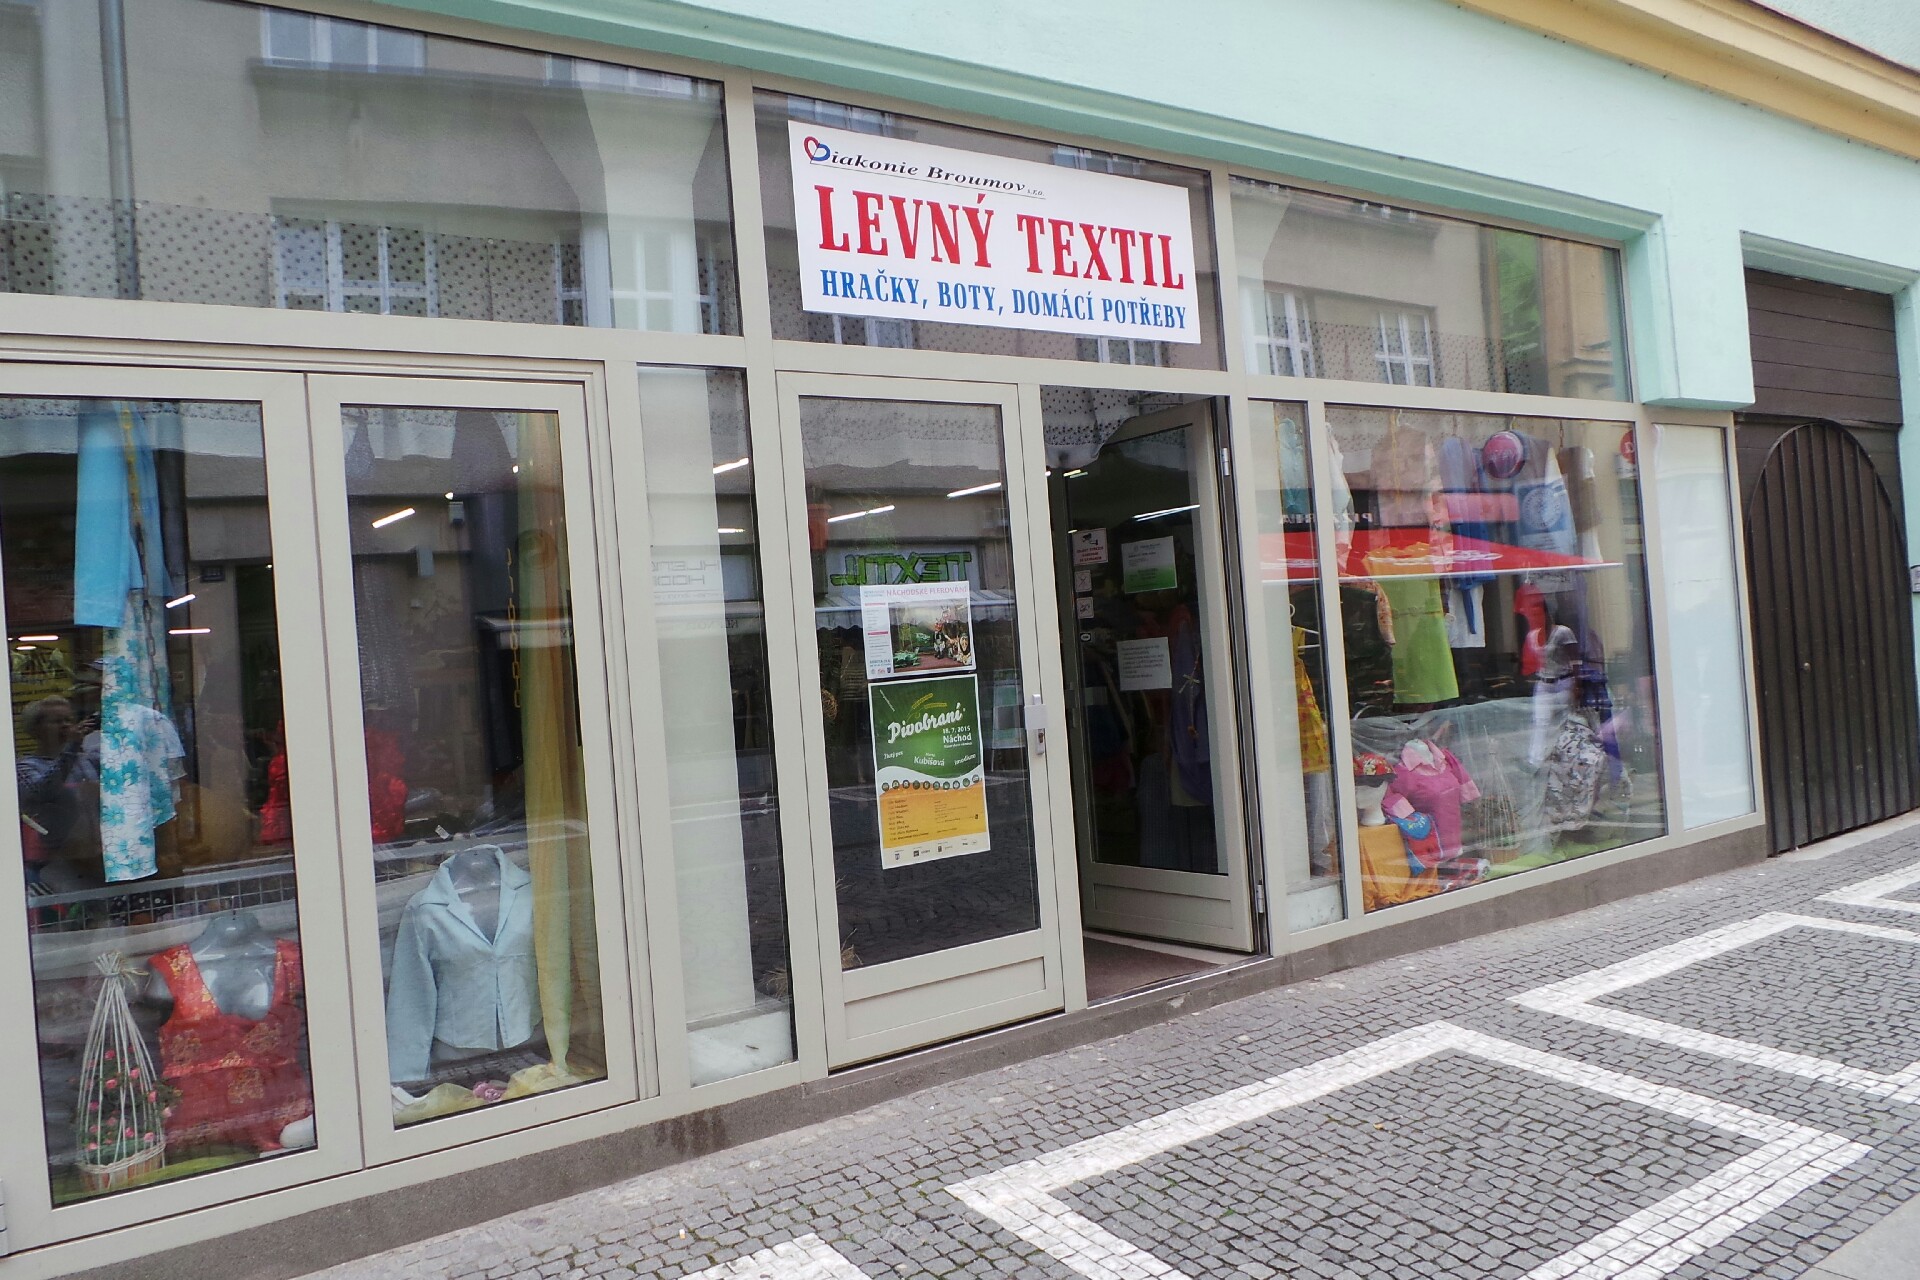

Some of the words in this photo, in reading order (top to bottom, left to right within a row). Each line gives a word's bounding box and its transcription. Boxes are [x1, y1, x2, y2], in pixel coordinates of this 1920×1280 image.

[810, 143, 918, 175] Diakonie
[926, 166, 1025, 191] Broumov
[813, 184, 994, 268] LEVNÝ
[1016, 213, 1184, 290] TEXTIL
[820, 268, 928, 310] HRAČKY,
[938, 281, 1004, 316] BOTY,
[1011, 288, 1095, 322] DOMÁCÍ
[1101, 296, 1187, 329] POTŘEBY
[887, 702, 963, 743] Pivobraní
[943, 732, 972, 744] Náchod
[958, 725, 971, 733] 2015
[913, 755, 945, 767] Kubišová
